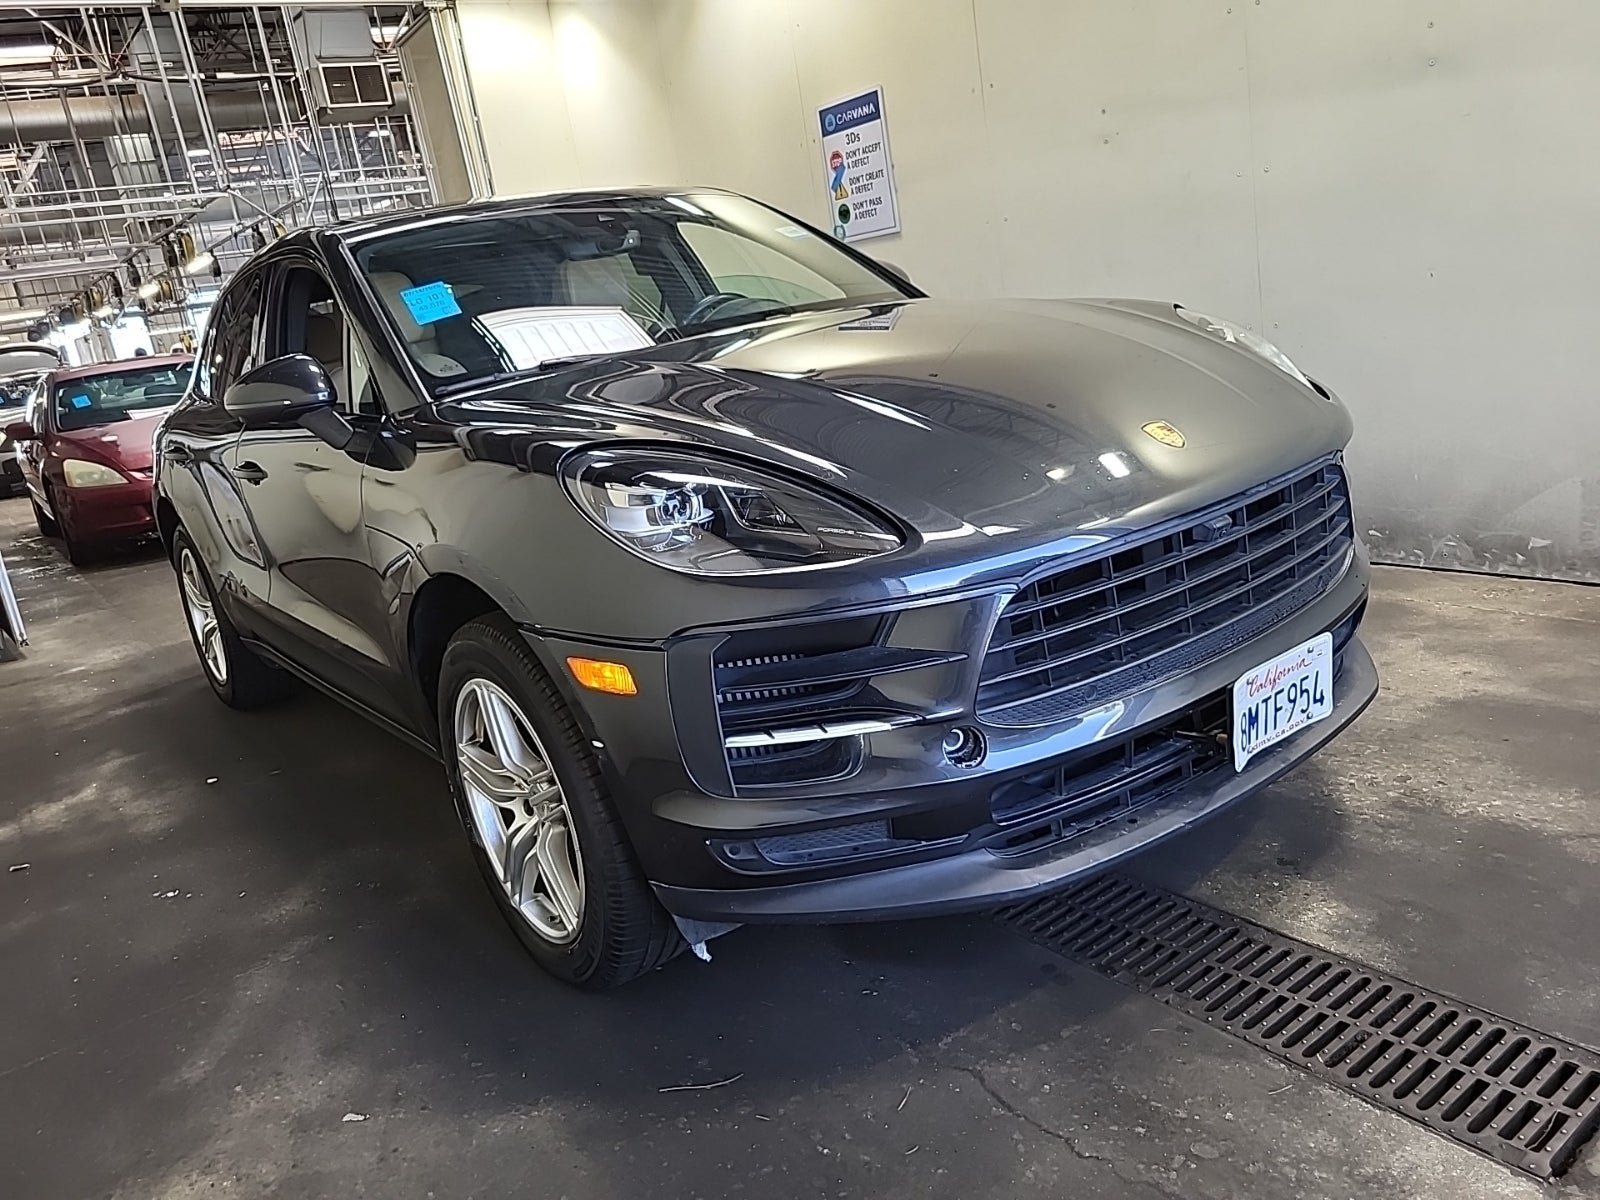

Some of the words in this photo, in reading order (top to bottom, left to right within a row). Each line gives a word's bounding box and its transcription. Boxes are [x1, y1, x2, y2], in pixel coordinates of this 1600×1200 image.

[836, 103, 876, 125] CARVANA
[845, 131, 861, 146] 3Ds
[845, 147, 861, 160] DON'T
[862, 141, 881, 155] ACCEPT
[851, 155, 870, 169] DEFECT
[849, 174, 865, 186] DON'T
[865, 169, 885, 182] CREATE
[854, 182, 874, 195] DEFECT
[852, 199, 868, 211] DON'T
[868, 196, 883, 207] PASS
[858, 207, 878, 219] DEFECT
[817, 527, 855, 535] PORSCHE
[1246, 657, 1313, 697] California
[1240, 669, 1325, 753] 8MTF954
